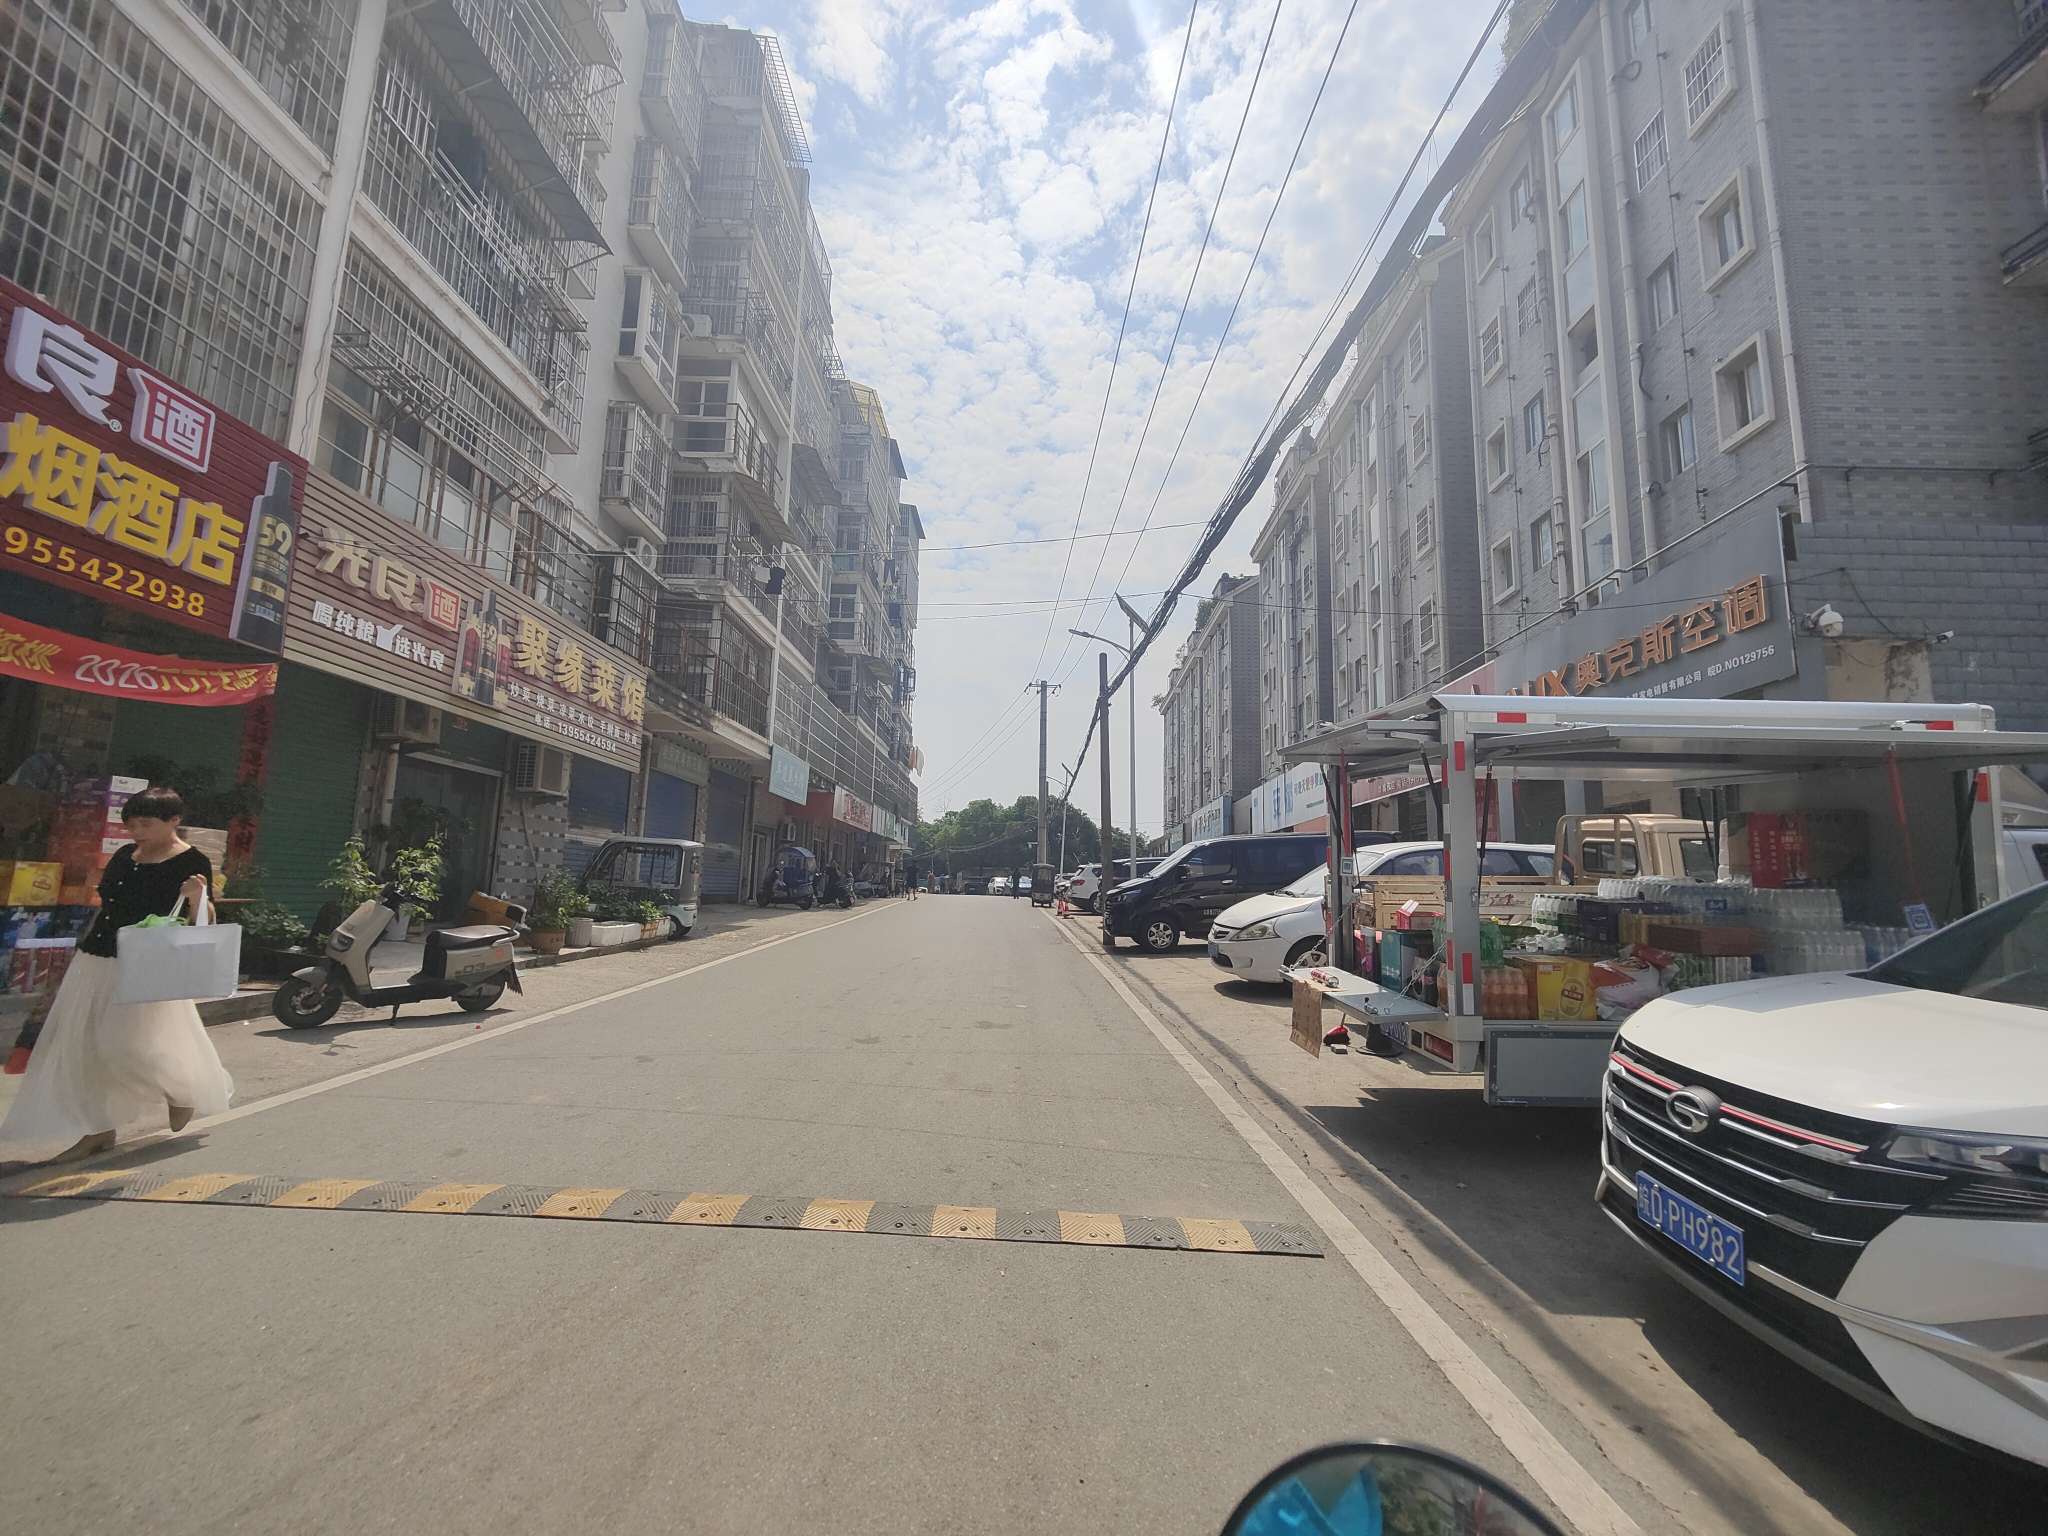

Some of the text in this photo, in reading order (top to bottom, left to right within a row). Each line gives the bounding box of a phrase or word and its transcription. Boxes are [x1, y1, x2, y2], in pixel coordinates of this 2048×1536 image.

[0, 412, 245, 585] 烟酒店
[258, 515, 293, 556] 59
[5, 527, 206, 617] 955422938
[1575, 574, 1767, 695] 奥克斯空调
